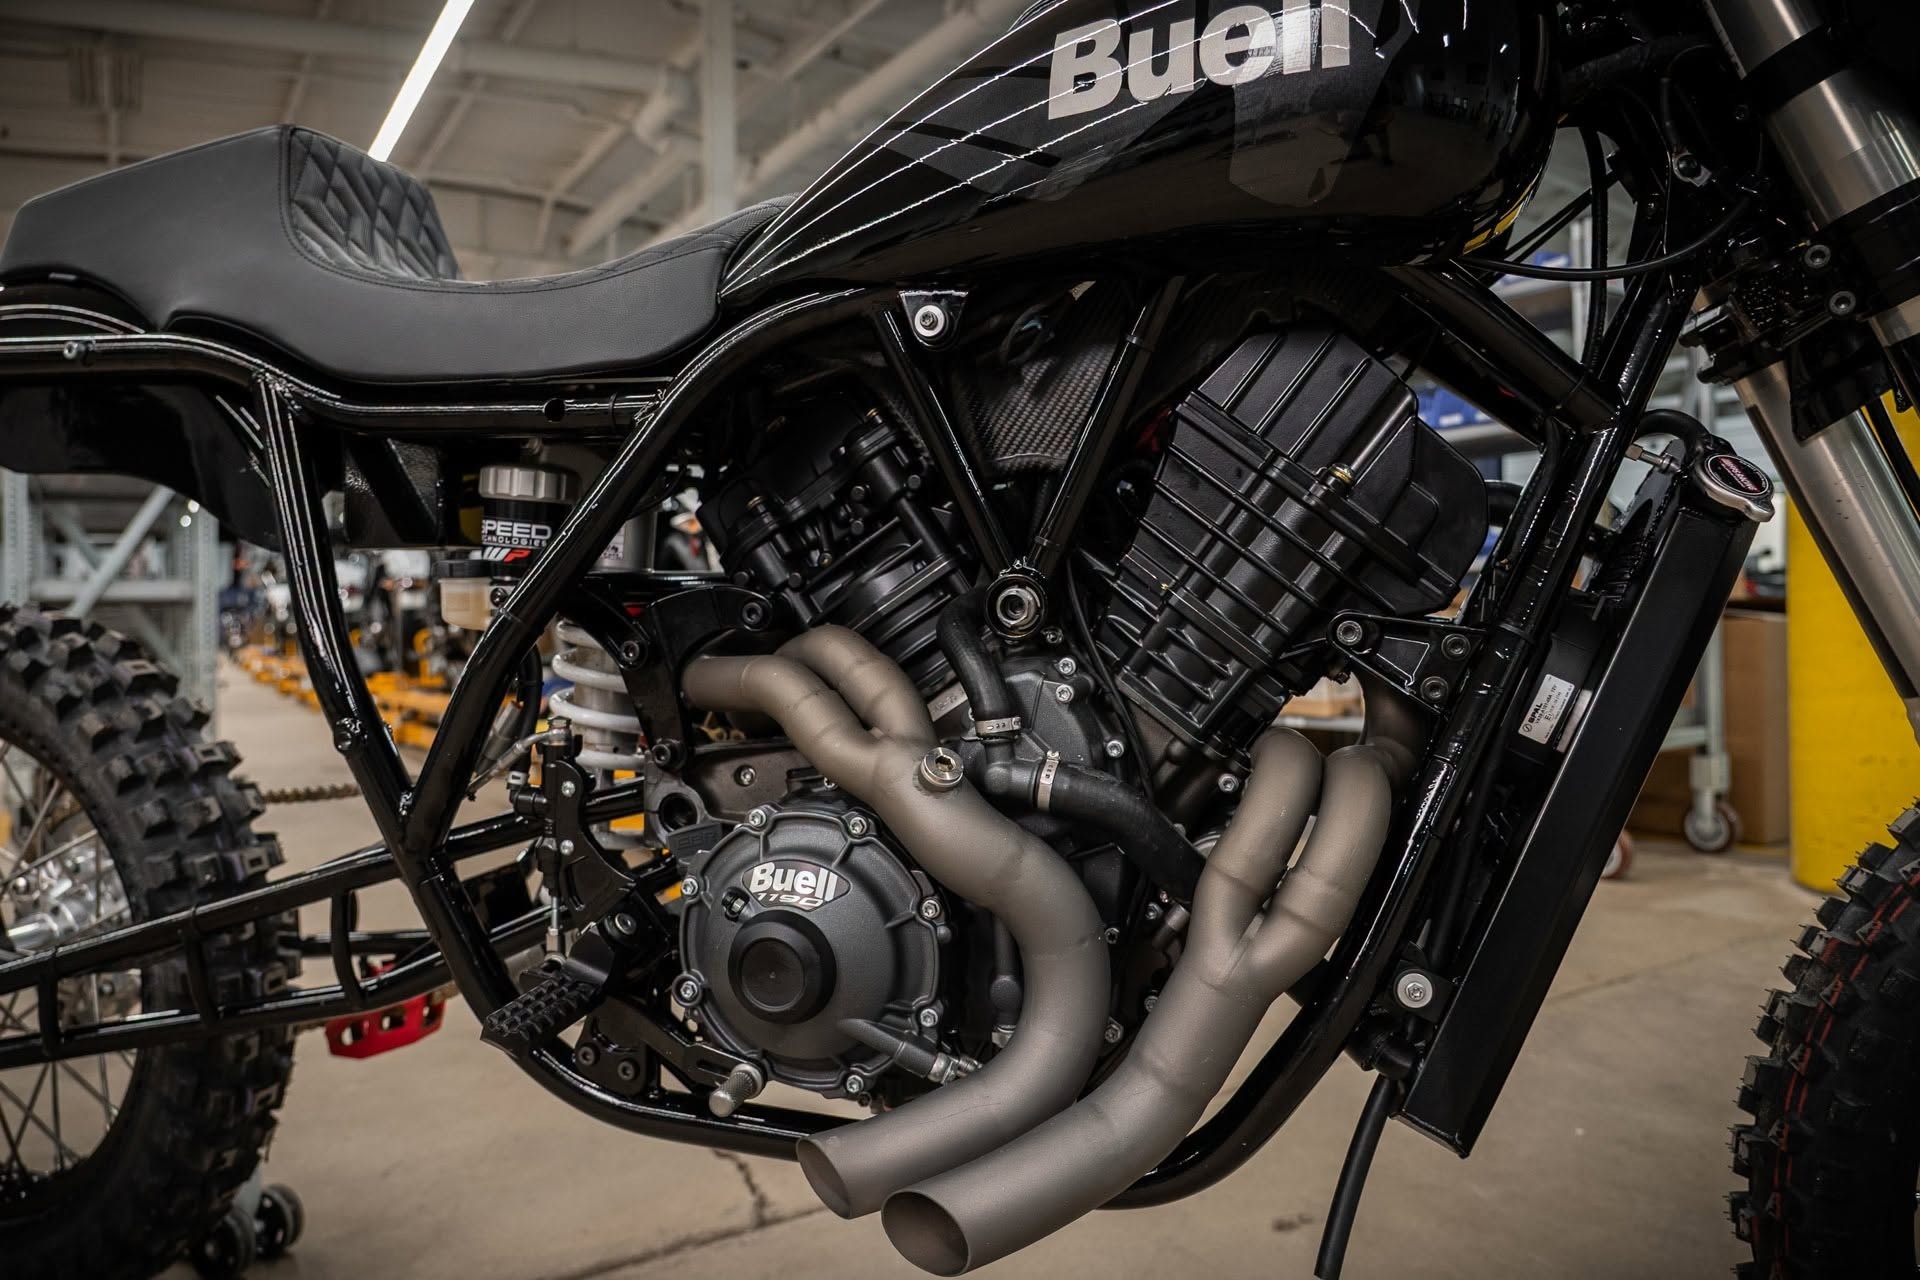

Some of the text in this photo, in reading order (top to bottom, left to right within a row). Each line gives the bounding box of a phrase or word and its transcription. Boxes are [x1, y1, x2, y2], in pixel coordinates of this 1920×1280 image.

[1047, 0, 1350, 120] Buell
[749, 862, 838, 902] Buell
[756, 892, 824, 907] 1190
